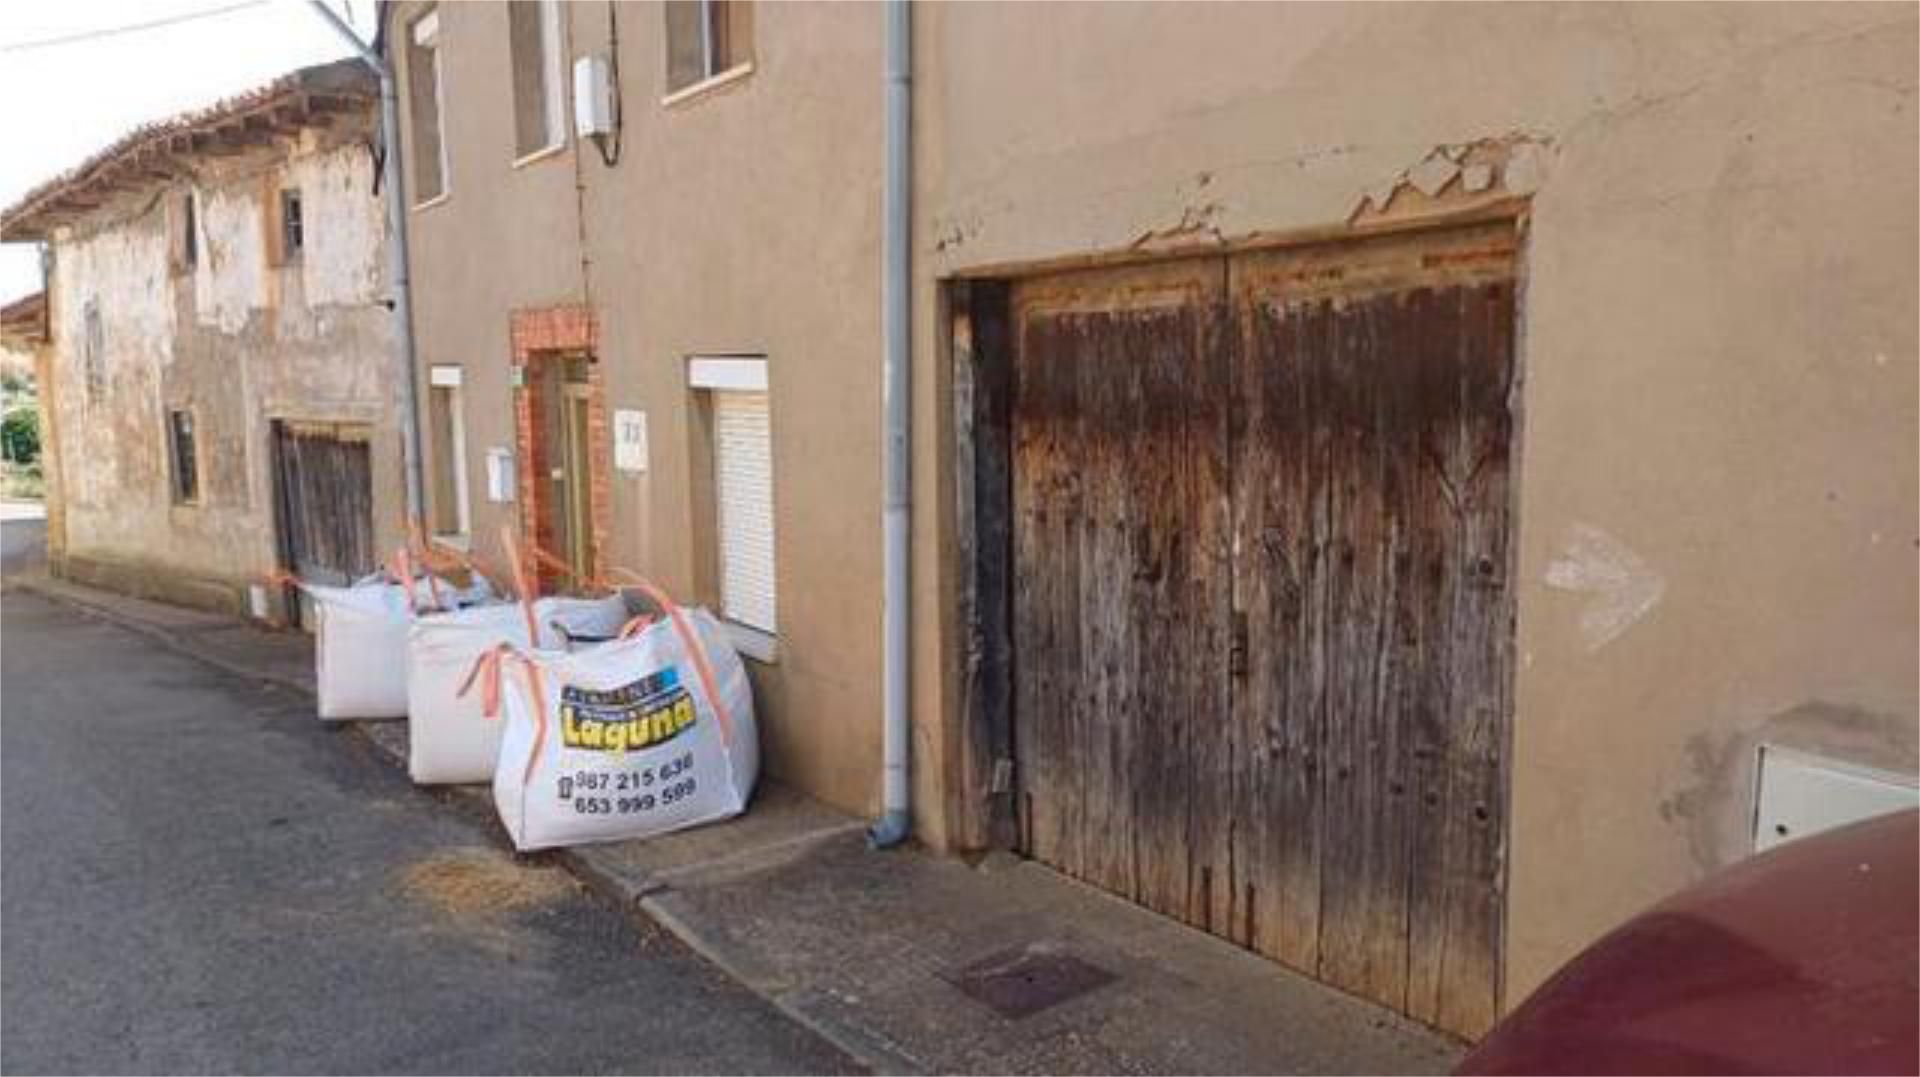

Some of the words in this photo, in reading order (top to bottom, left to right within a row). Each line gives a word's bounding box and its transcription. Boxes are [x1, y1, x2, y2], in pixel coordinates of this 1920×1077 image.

[562, 693, 695, 750] Laguna
[616, 768, 655, 790] 215
[576, 797, 611, 814] 653
